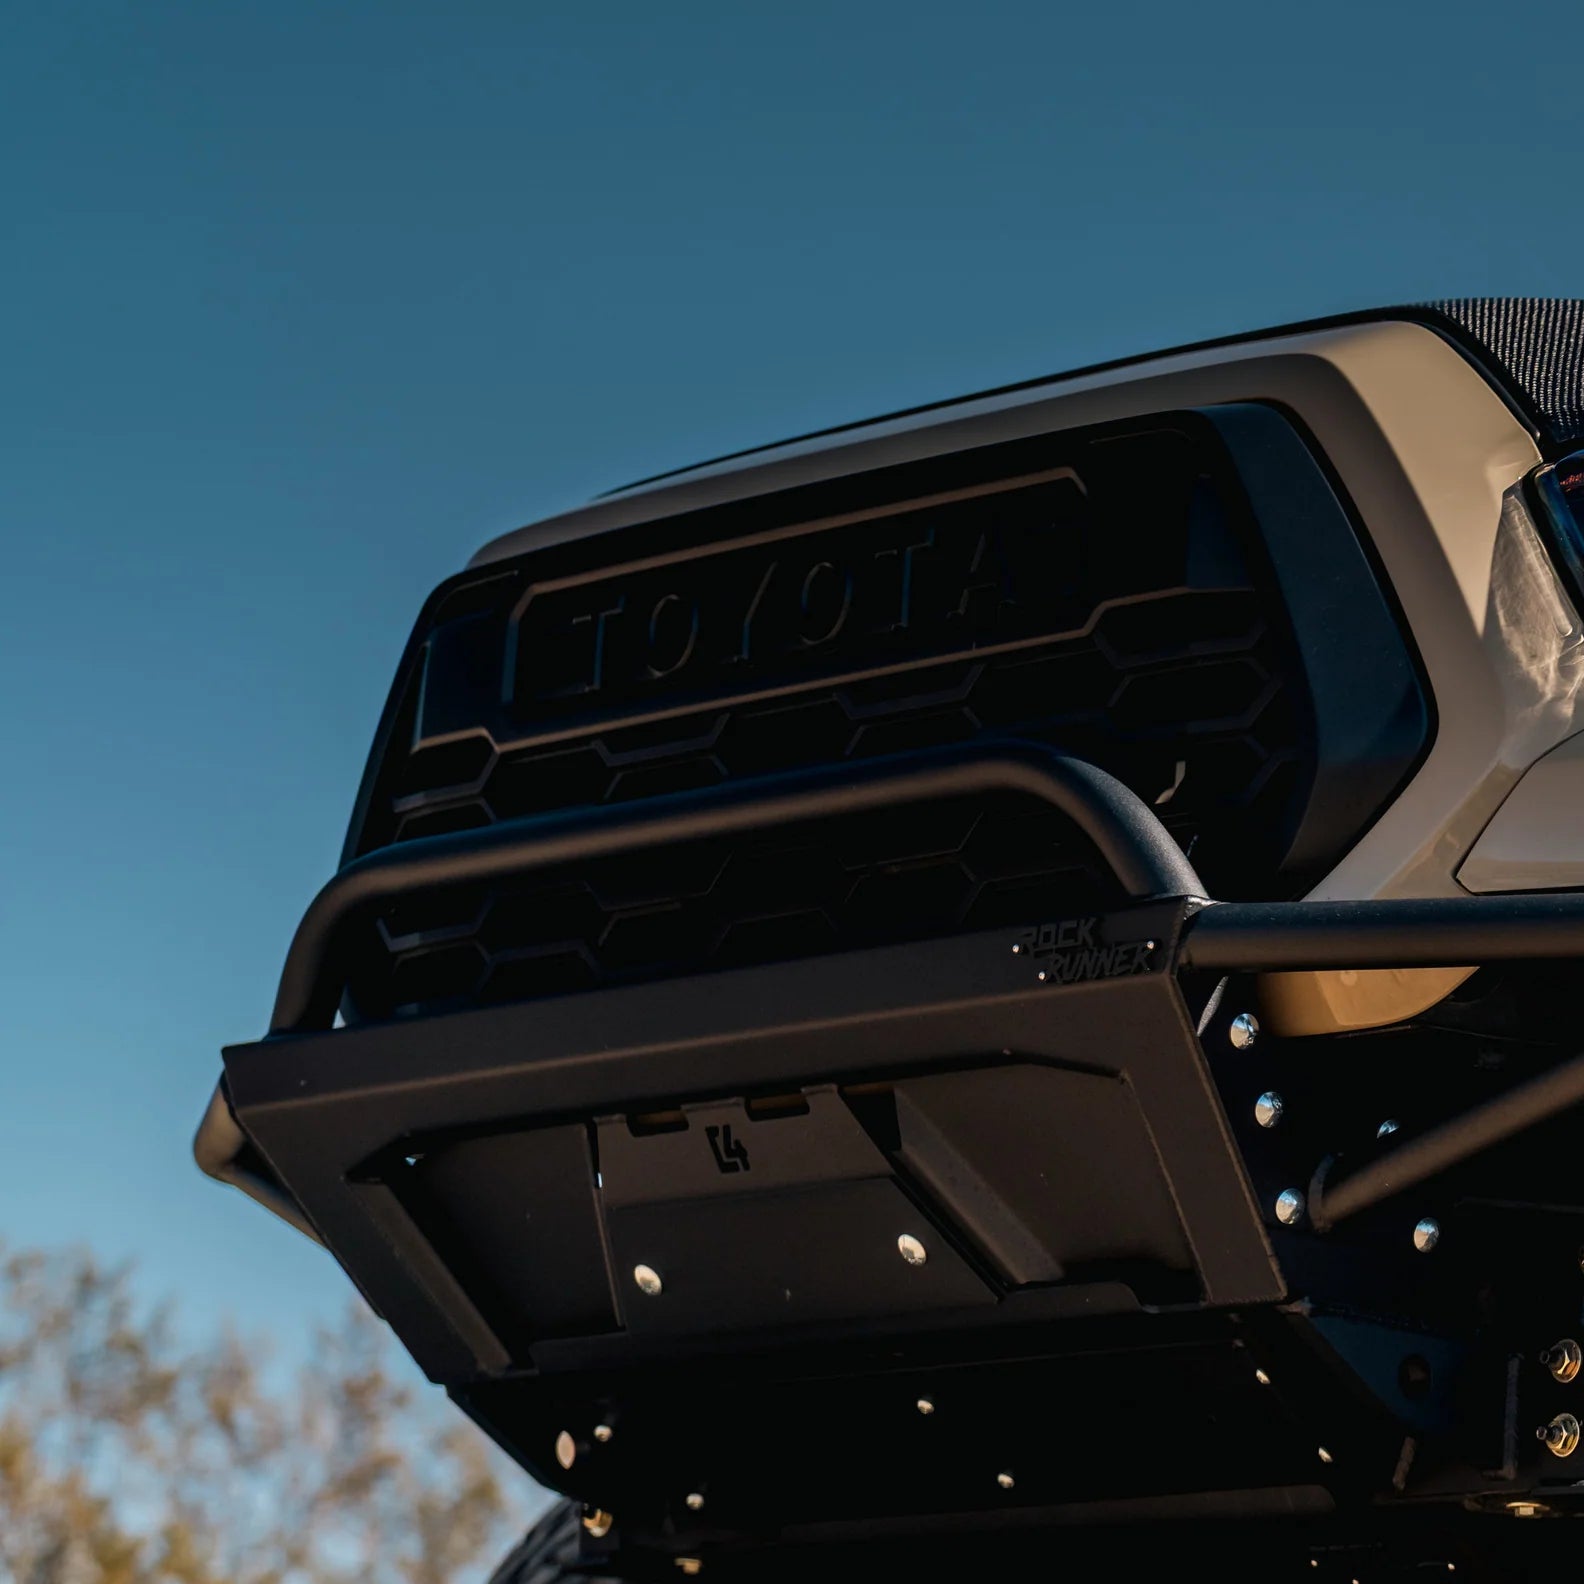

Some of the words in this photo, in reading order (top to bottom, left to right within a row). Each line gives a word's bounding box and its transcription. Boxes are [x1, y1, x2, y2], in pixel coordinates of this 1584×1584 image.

[568, 530, 1020, 692] TOYOTA
[1017, 917, 1097, 951] ROCK
[1048, 940, 1152, 984] RUNNER
